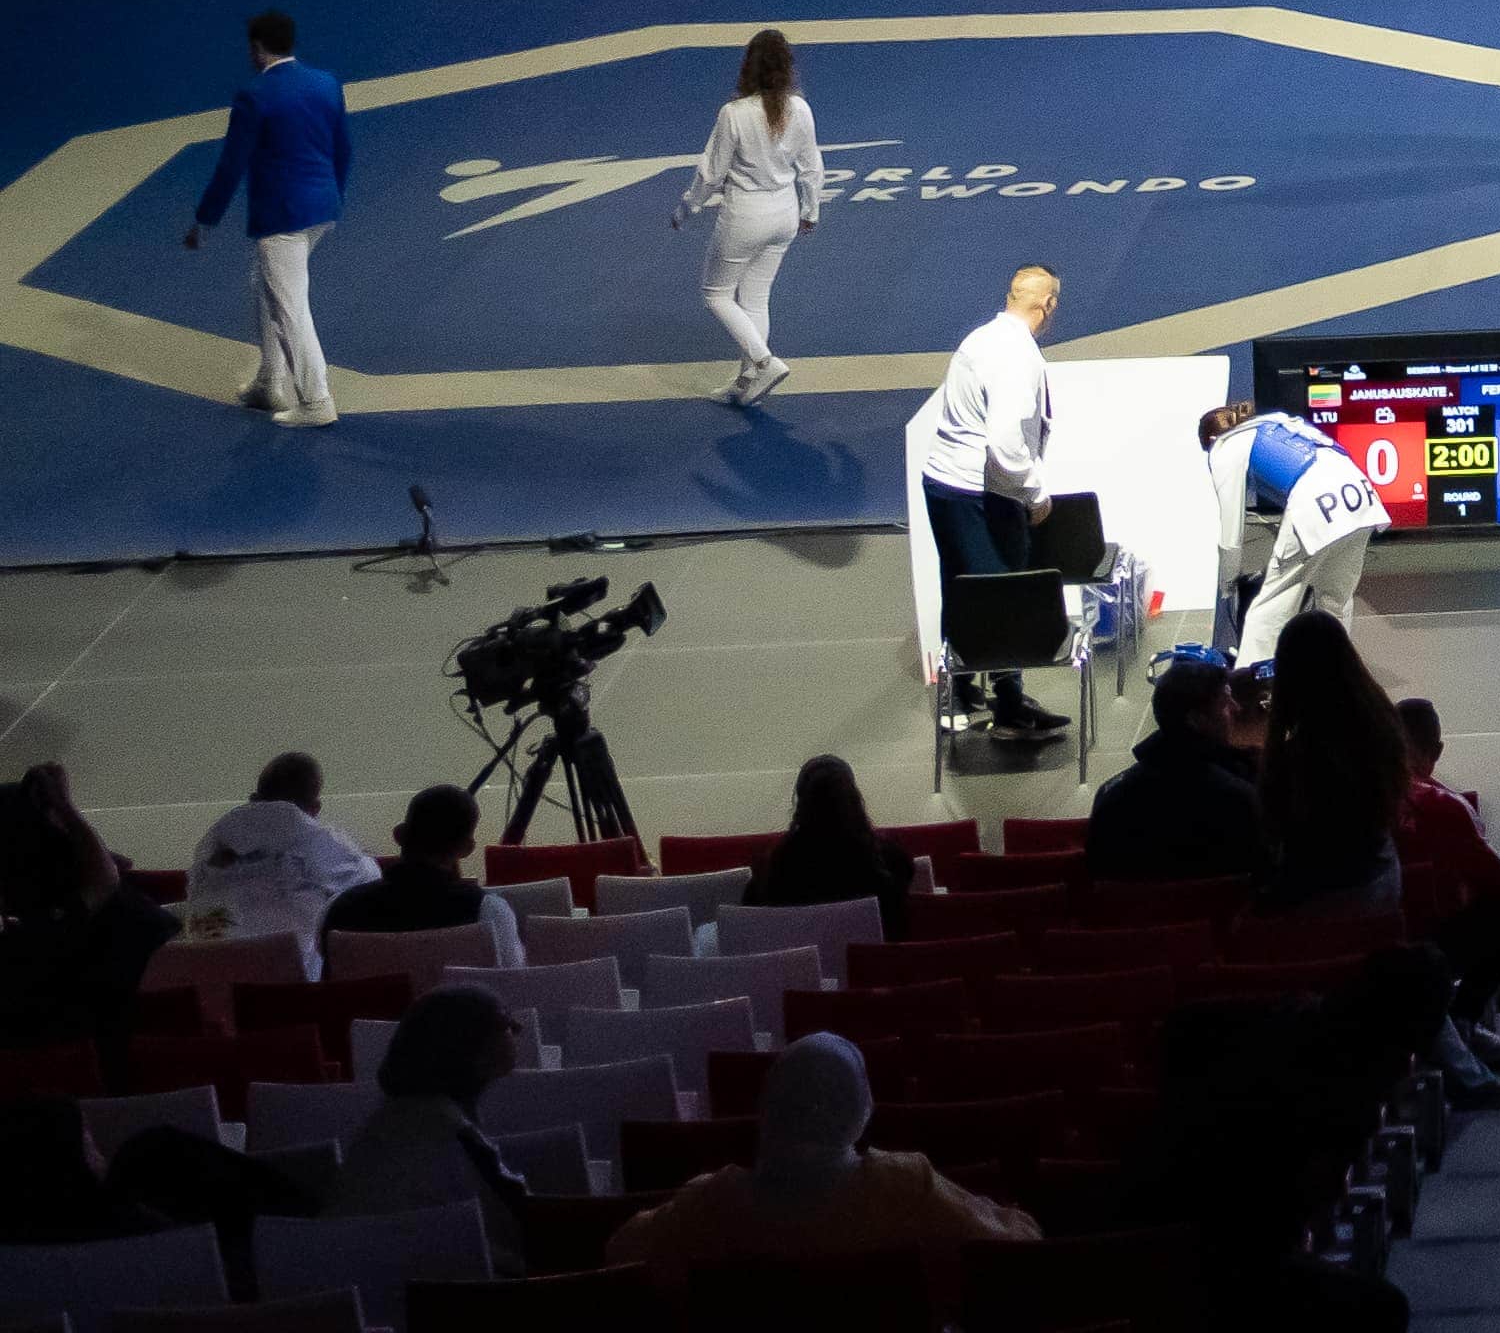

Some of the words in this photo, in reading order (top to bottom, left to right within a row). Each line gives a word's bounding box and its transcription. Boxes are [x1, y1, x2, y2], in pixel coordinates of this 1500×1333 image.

[823, 164, 1018, 184] ORLD
[816, 175, 1257, 204] EKWONDO
[1313, 411, 1338, 424] LTU
[1442, 406, 1479, 417] MATCH
[1446, 419, 1475, 433] 301
[1366, 439, 1399, 486] 0
[1432, 444, 1490, 469] 2:00
[1444, 491, 1481, 503] ROUND
[1458, 504, 1466, 516] 1
